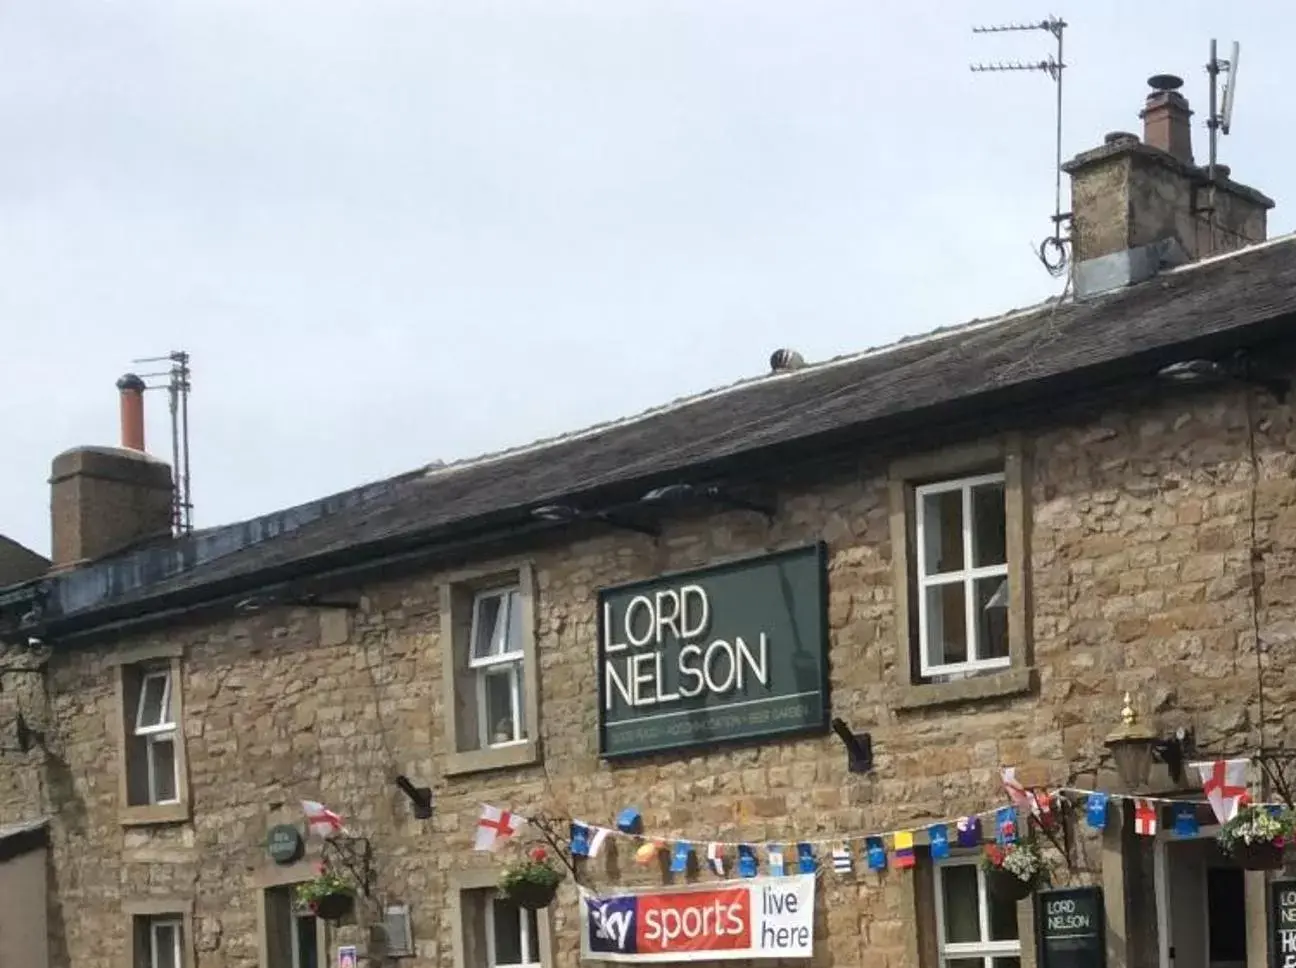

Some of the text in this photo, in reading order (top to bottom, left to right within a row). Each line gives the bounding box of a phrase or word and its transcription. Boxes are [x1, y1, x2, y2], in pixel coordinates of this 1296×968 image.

[604, 585, 709, 651] LORD
[605, 633, 766, 710] NELSON
[763, 887, 798, 915] live
[1047, 899, 1075, 914] LORD
[591, 900, 744, 949] sky sports
[761, 922, 809, 948] here
[1048, 914, 1089, 929] NELSON
